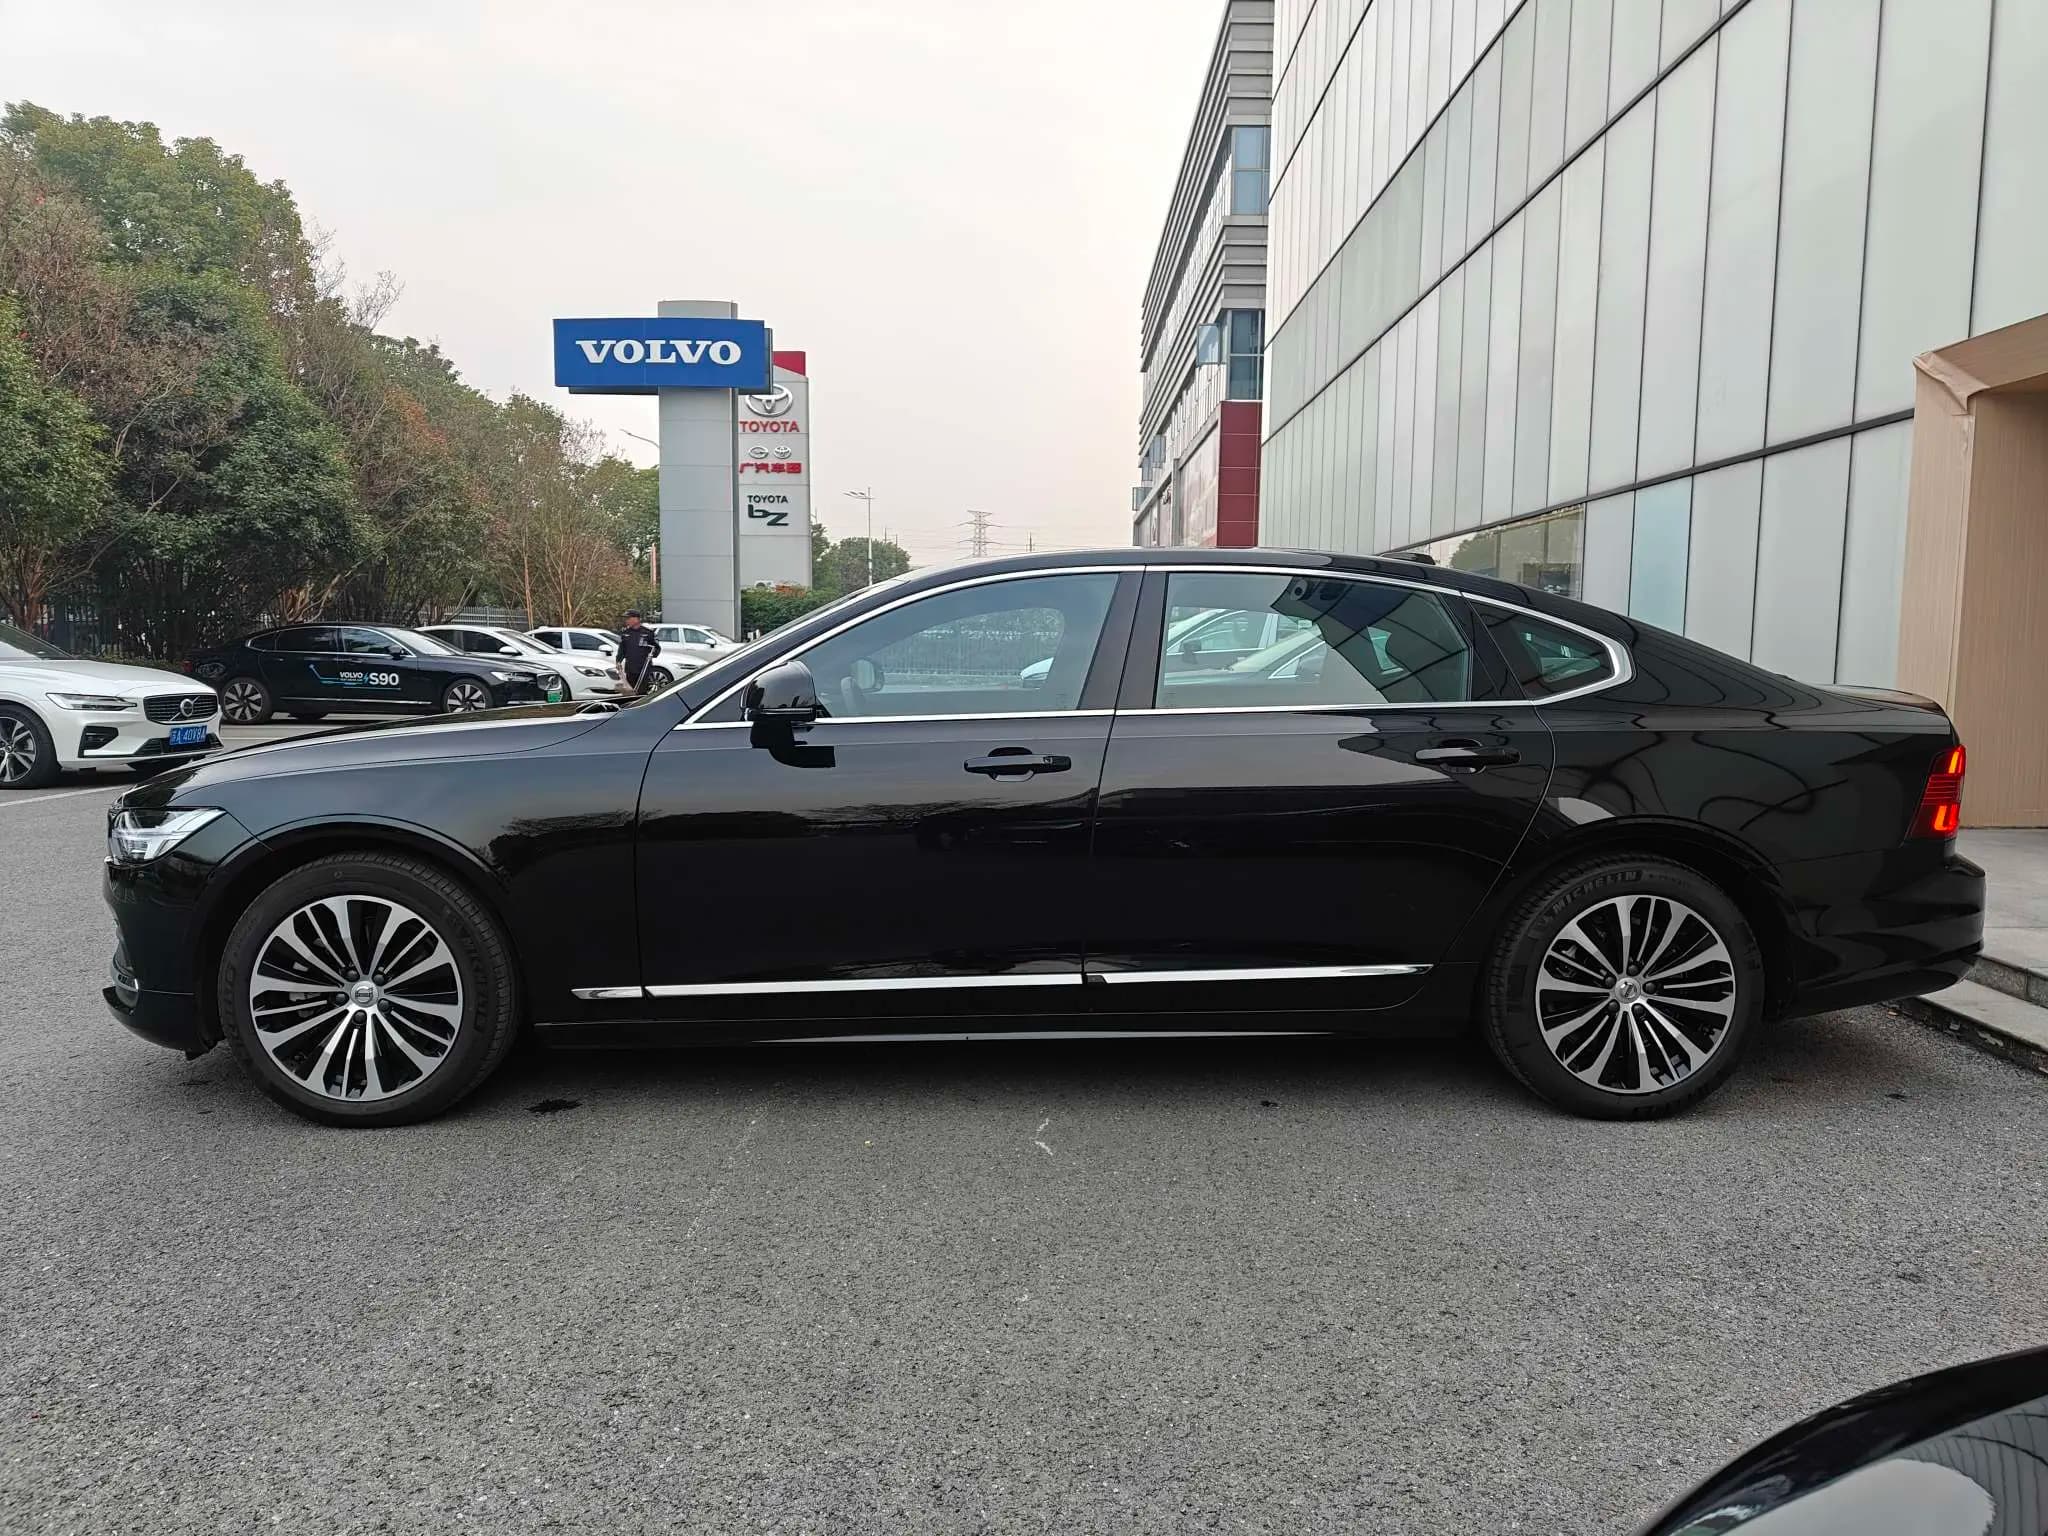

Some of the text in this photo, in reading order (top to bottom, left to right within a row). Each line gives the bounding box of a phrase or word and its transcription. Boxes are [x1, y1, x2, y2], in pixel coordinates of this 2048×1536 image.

[575, 339, 742, 365] VOLVO
[739, 420, 800, 433] TOYOTA
[747, 495, 789, 504] TOYOTA
[339, 671, 400, 686] VOLVO S90
